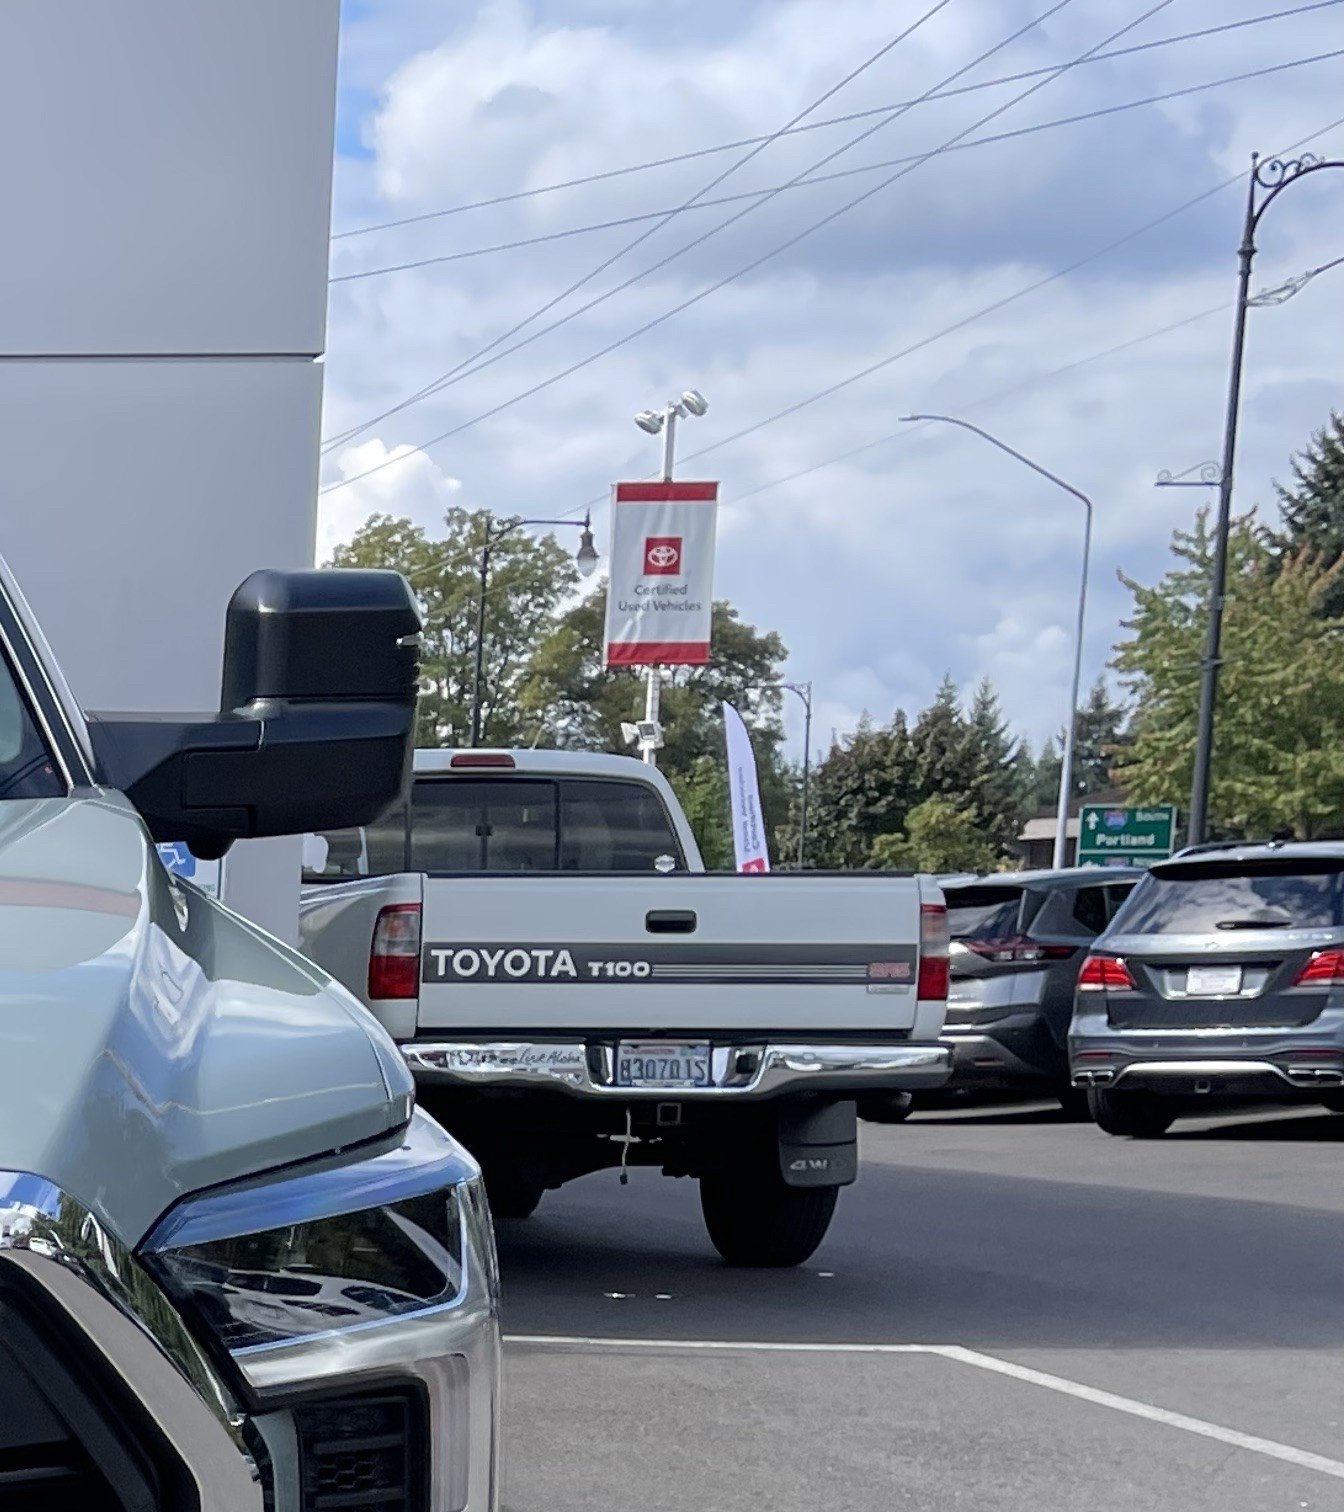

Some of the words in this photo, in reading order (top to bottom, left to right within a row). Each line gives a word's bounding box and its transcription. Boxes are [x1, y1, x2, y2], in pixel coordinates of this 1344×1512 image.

[634, 583, 689, 596] Certified
[618, 600, 650, 611] Used
[652, 600, 701, 611] Vehicles
[1095, 833, 1155, 846] Portland
[430, 949, 578, 977] TOYOTA
[588, 961, 650, 977] T100
